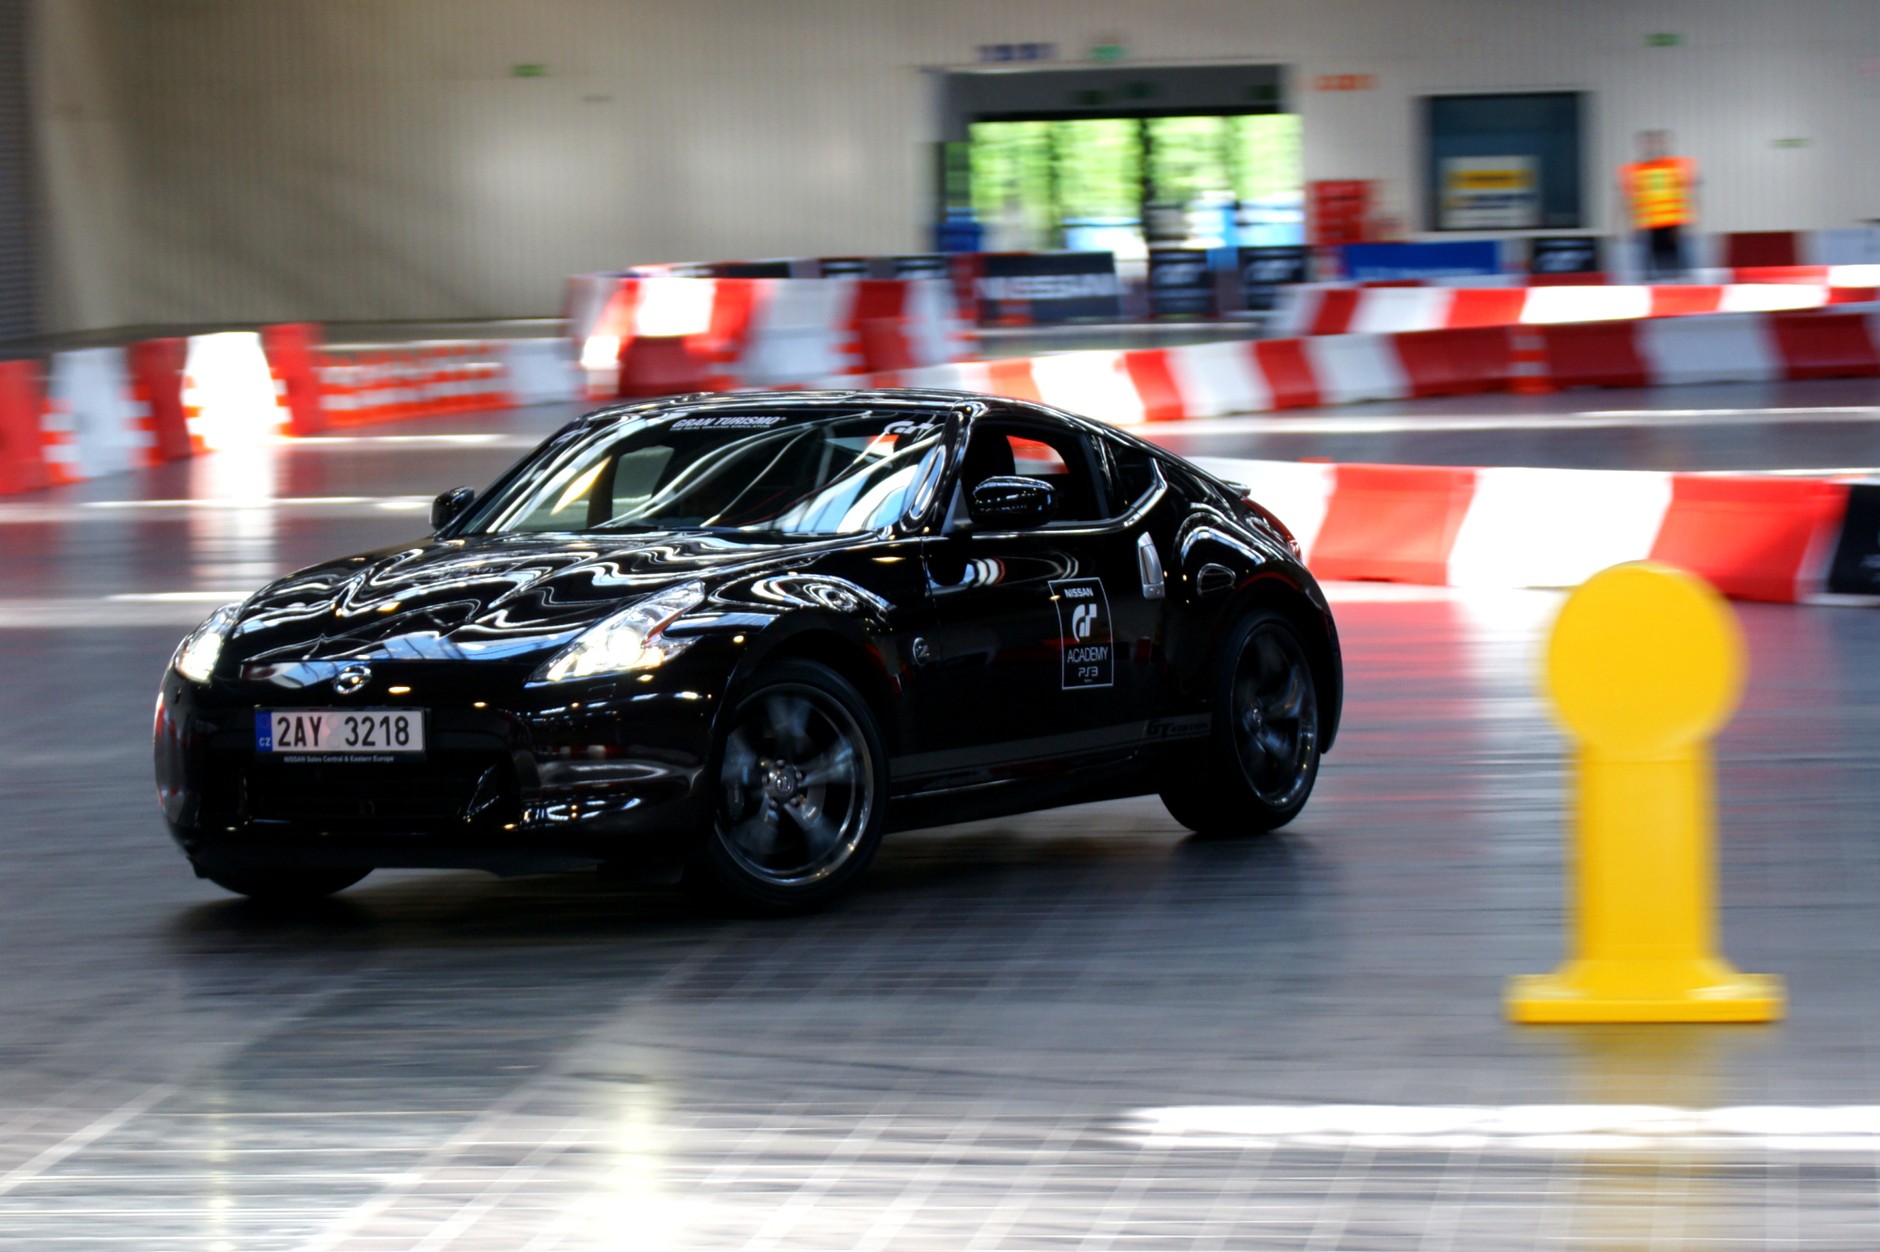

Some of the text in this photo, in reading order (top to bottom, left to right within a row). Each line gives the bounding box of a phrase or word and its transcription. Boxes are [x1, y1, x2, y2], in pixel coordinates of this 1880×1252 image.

[671, 417, 716, 428] GRAN
[714, 416, 781, 426] TURISMO
[1064, 587, 1094, 598] NISSAN
[1067, 646, 1108, 663] ACADEMY
[1078, 666, 1098, 678] PS3
[277, 715, 410, 747] 2AY 3218
[259, 737, 271, 747] CZ
[323, 755, 343, 763] Central
[350, 755, 372, 763] Eastern
[373, 754, 395, 763] Europe
